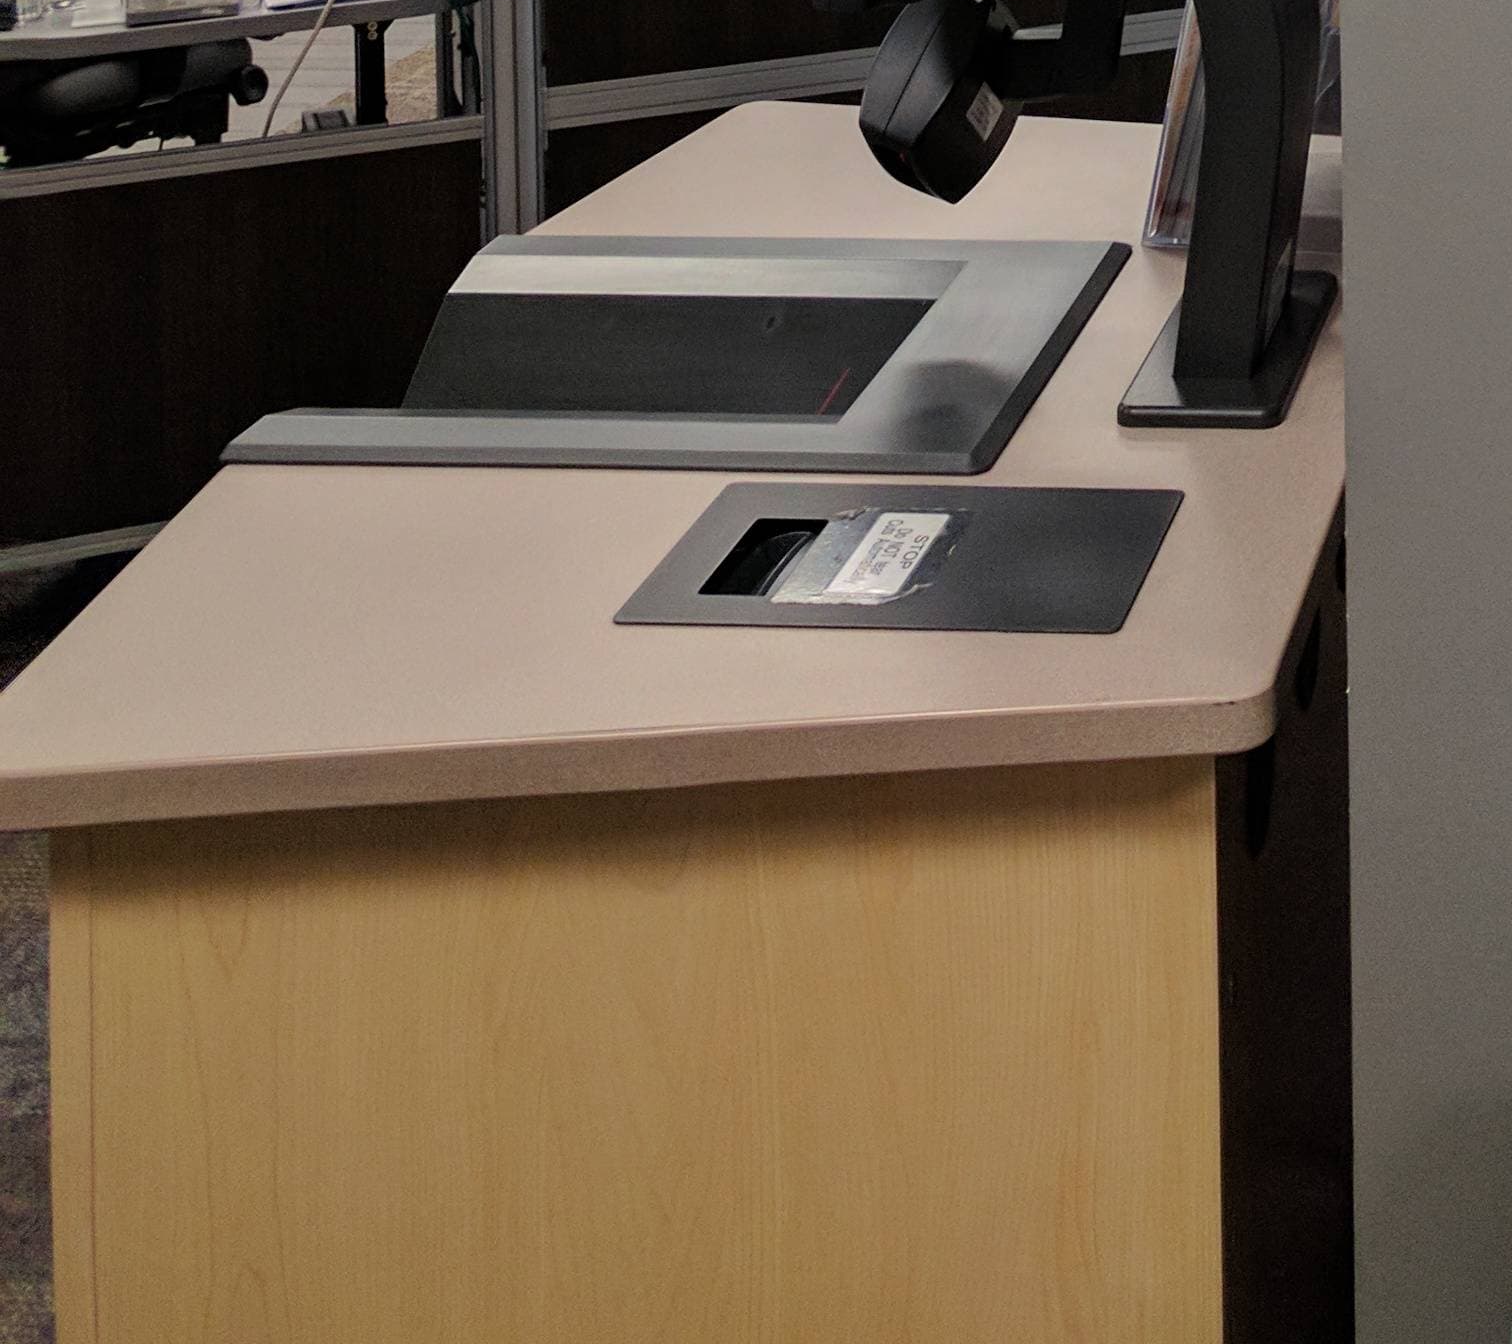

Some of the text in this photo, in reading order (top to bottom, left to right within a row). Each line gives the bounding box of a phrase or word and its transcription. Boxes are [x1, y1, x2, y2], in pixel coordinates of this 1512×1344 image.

[894, 528, 913, 539] Do
[881, 541, 904, 558] NOT
[900, 534, 929, 570] STOP
